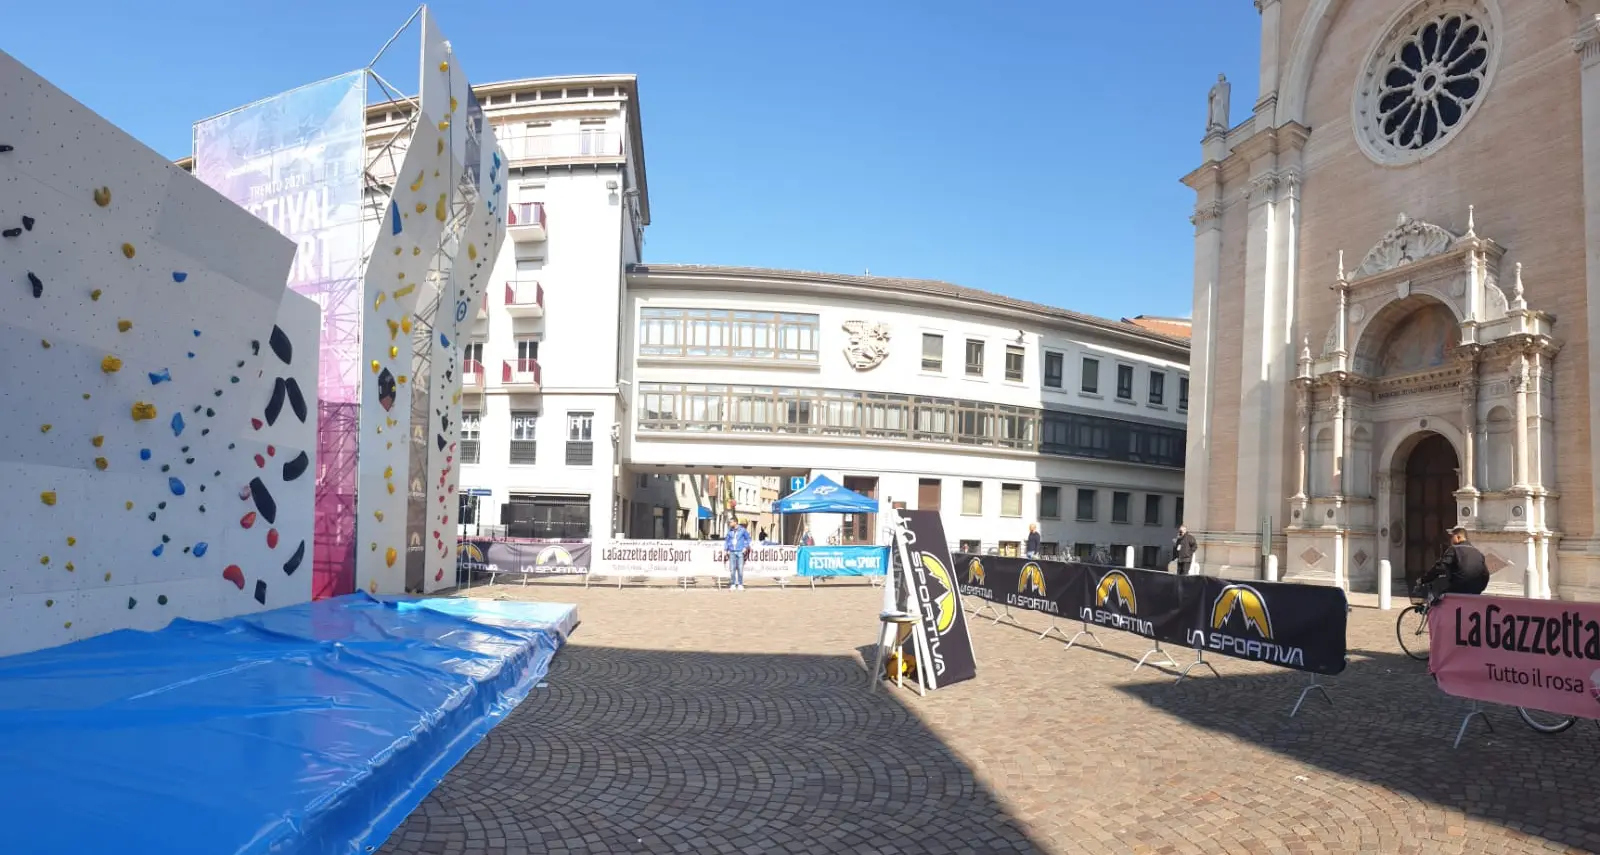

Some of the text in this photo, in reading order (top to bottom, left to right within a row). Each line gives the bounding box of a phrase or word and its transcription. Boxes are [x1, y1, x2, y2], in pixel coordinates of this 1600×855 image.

[250, 186, 334, 233] TIVAL
[648, 547, 668, 562] dello
[669, 548, 692, 564] Sport
[759, 547, 778, 562] dello
[779, 548, 797, 563] Spor
[809, 557, 844, 569] FESTIVAL
[857, 556, 881, 569] SPORT
[536, 565, 588, 573] SPORTIVA
[966, 585, 993, 600] SPORTIVA
[910, 551, 946, 677] SPORTIVA
[1007, 593, 1059, 614] LA SPORTIVA
[1079, 605, 1155, 637] LA SPORTIVA
[1186, 627, 1304, 667] LA SPORTIVA
[1485, 663, 1585, 694] Tutto il rosa
